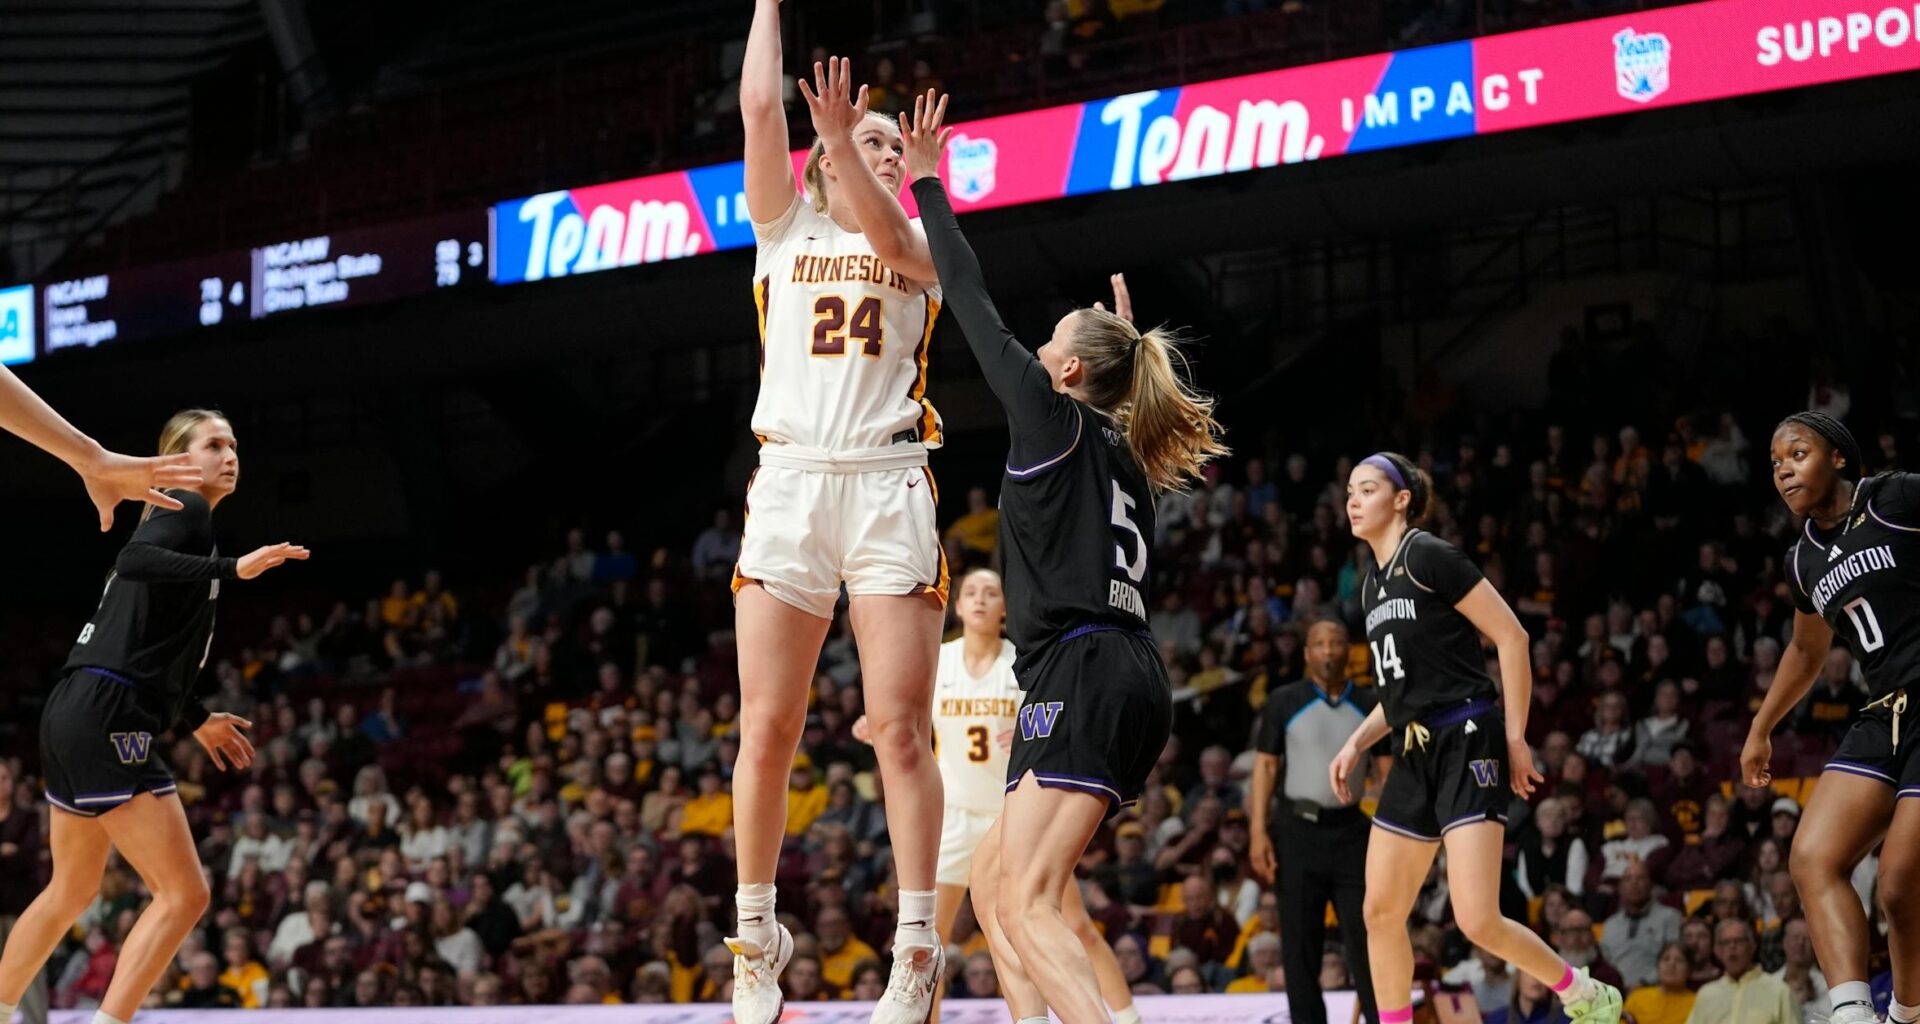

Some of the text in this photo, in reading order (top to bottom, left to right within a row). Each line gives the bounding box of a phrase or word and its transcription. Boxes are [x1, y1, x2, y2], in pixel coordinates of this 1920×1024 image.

[1756, 3, 1920, 66] SUPPO
[1341, 69, 1544, 133] IMPACT
[810, 293, 884, 358] 24
[1110, 478, 1148, 582] 5
[1811, 545, 1897, 618] WASHINGTON
[1842, 596, 1885, 654] 0
[1369, 632, 1406, 687] 14
[940, 697, 1017, 718] MINNESOTA
[1020, 701, 1063, 741] W
[110, 731, 153, 764] W
[966, 724, 990, 764] 3
[1469, 759, 1500, 788] W
